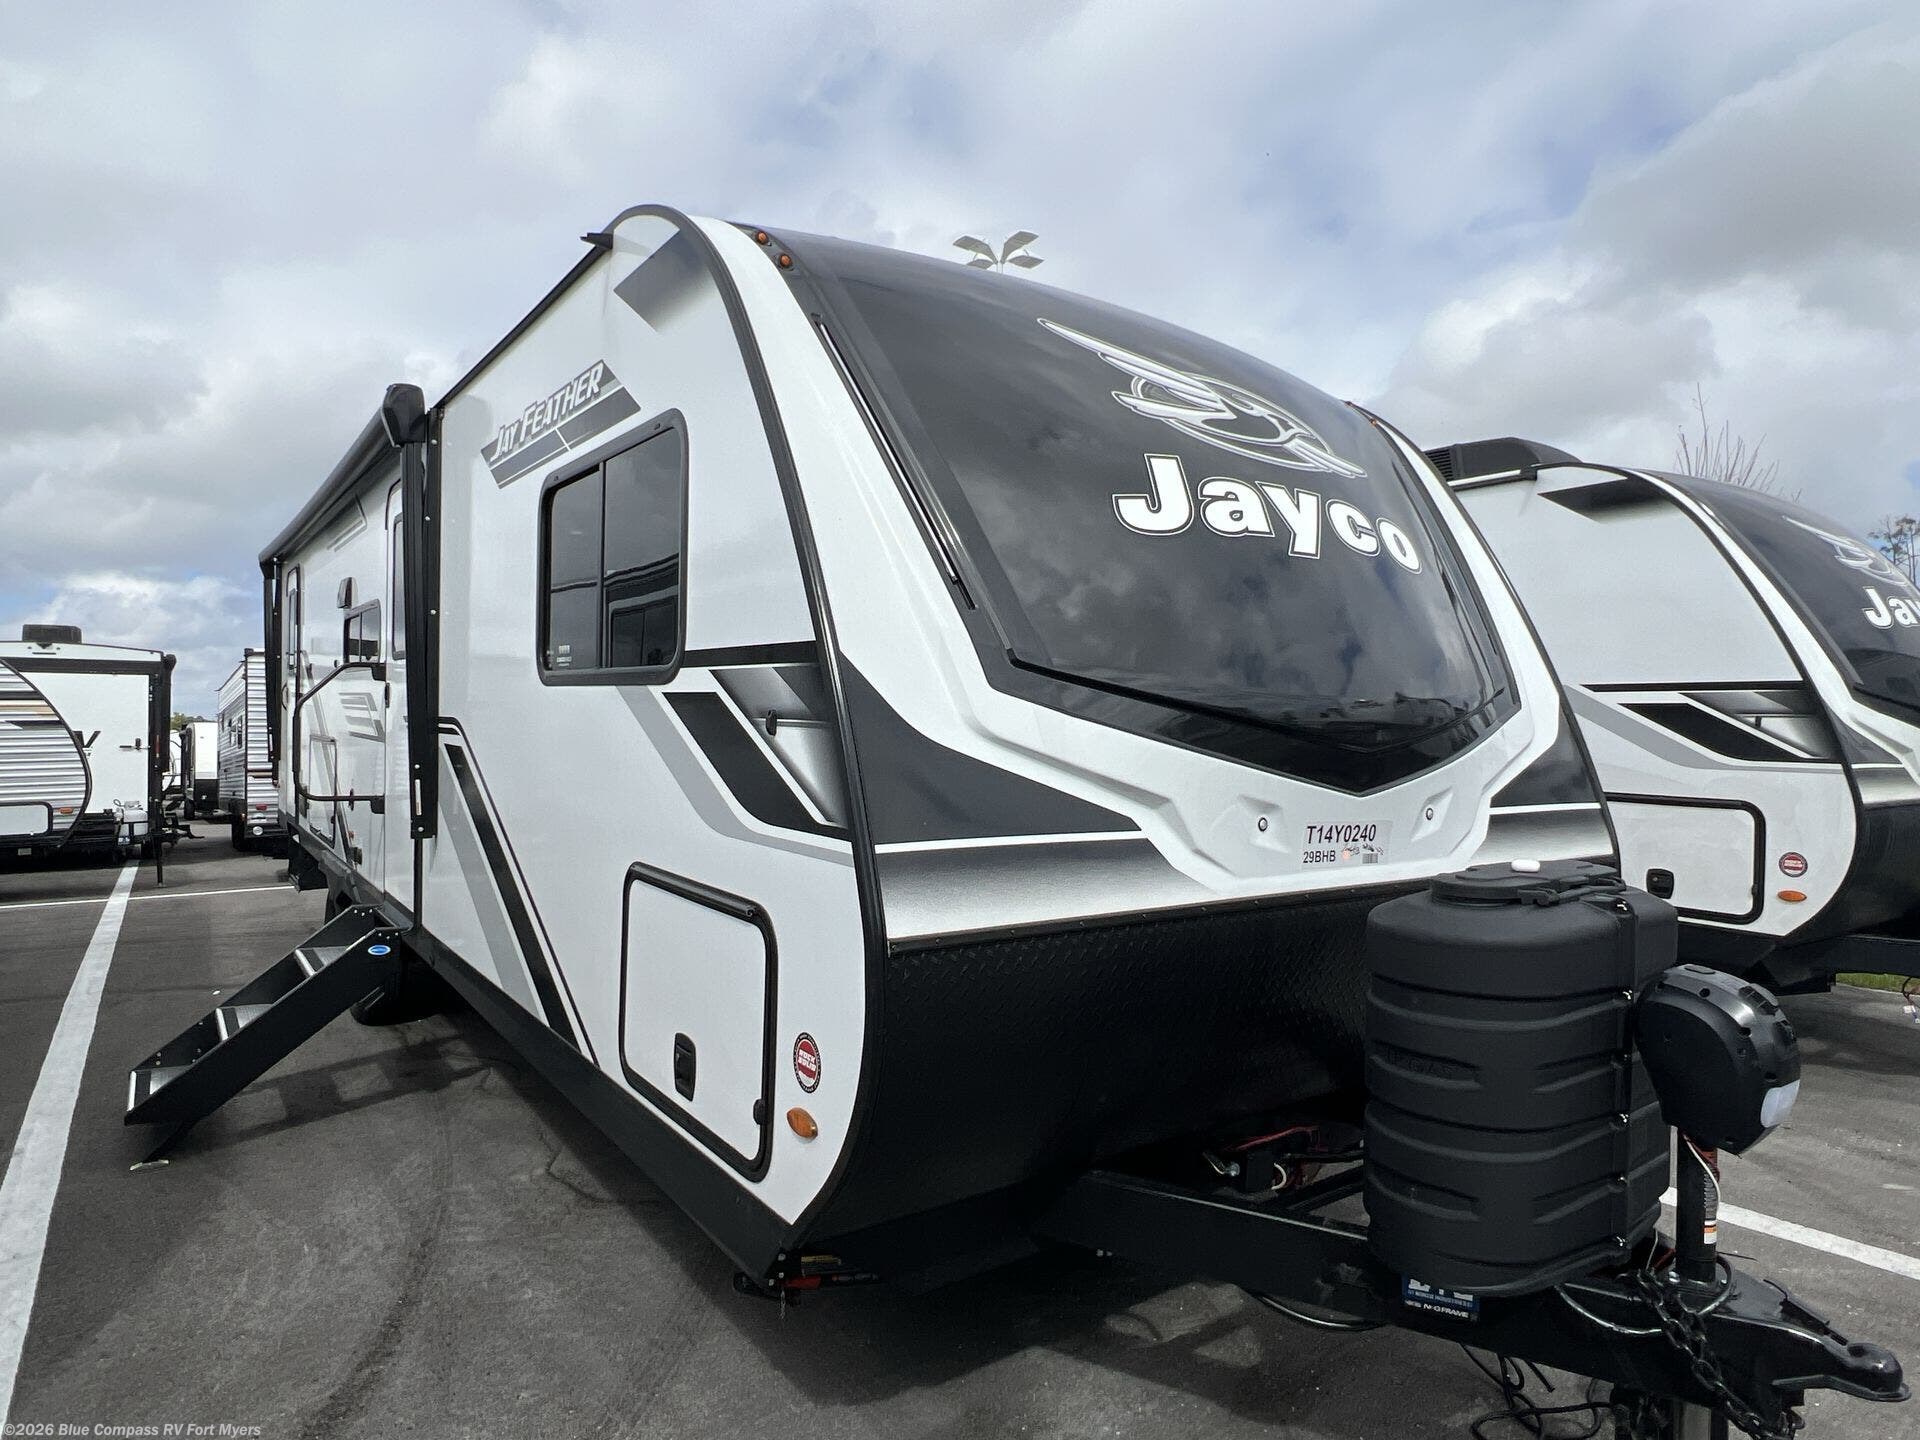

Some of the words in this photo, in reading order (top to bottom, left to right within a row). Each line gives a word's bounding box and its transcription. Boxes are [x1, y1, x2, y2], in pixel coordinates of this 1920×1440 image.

[490, 424, 520, 462] JAY
[519, 362, 604, 443] FEATHER
[1112, 453, 1422, 574] Jayco
[1303, 850, 1336, 863] 29BHB
[1307, 824, 1377, 844] T14Y0240
